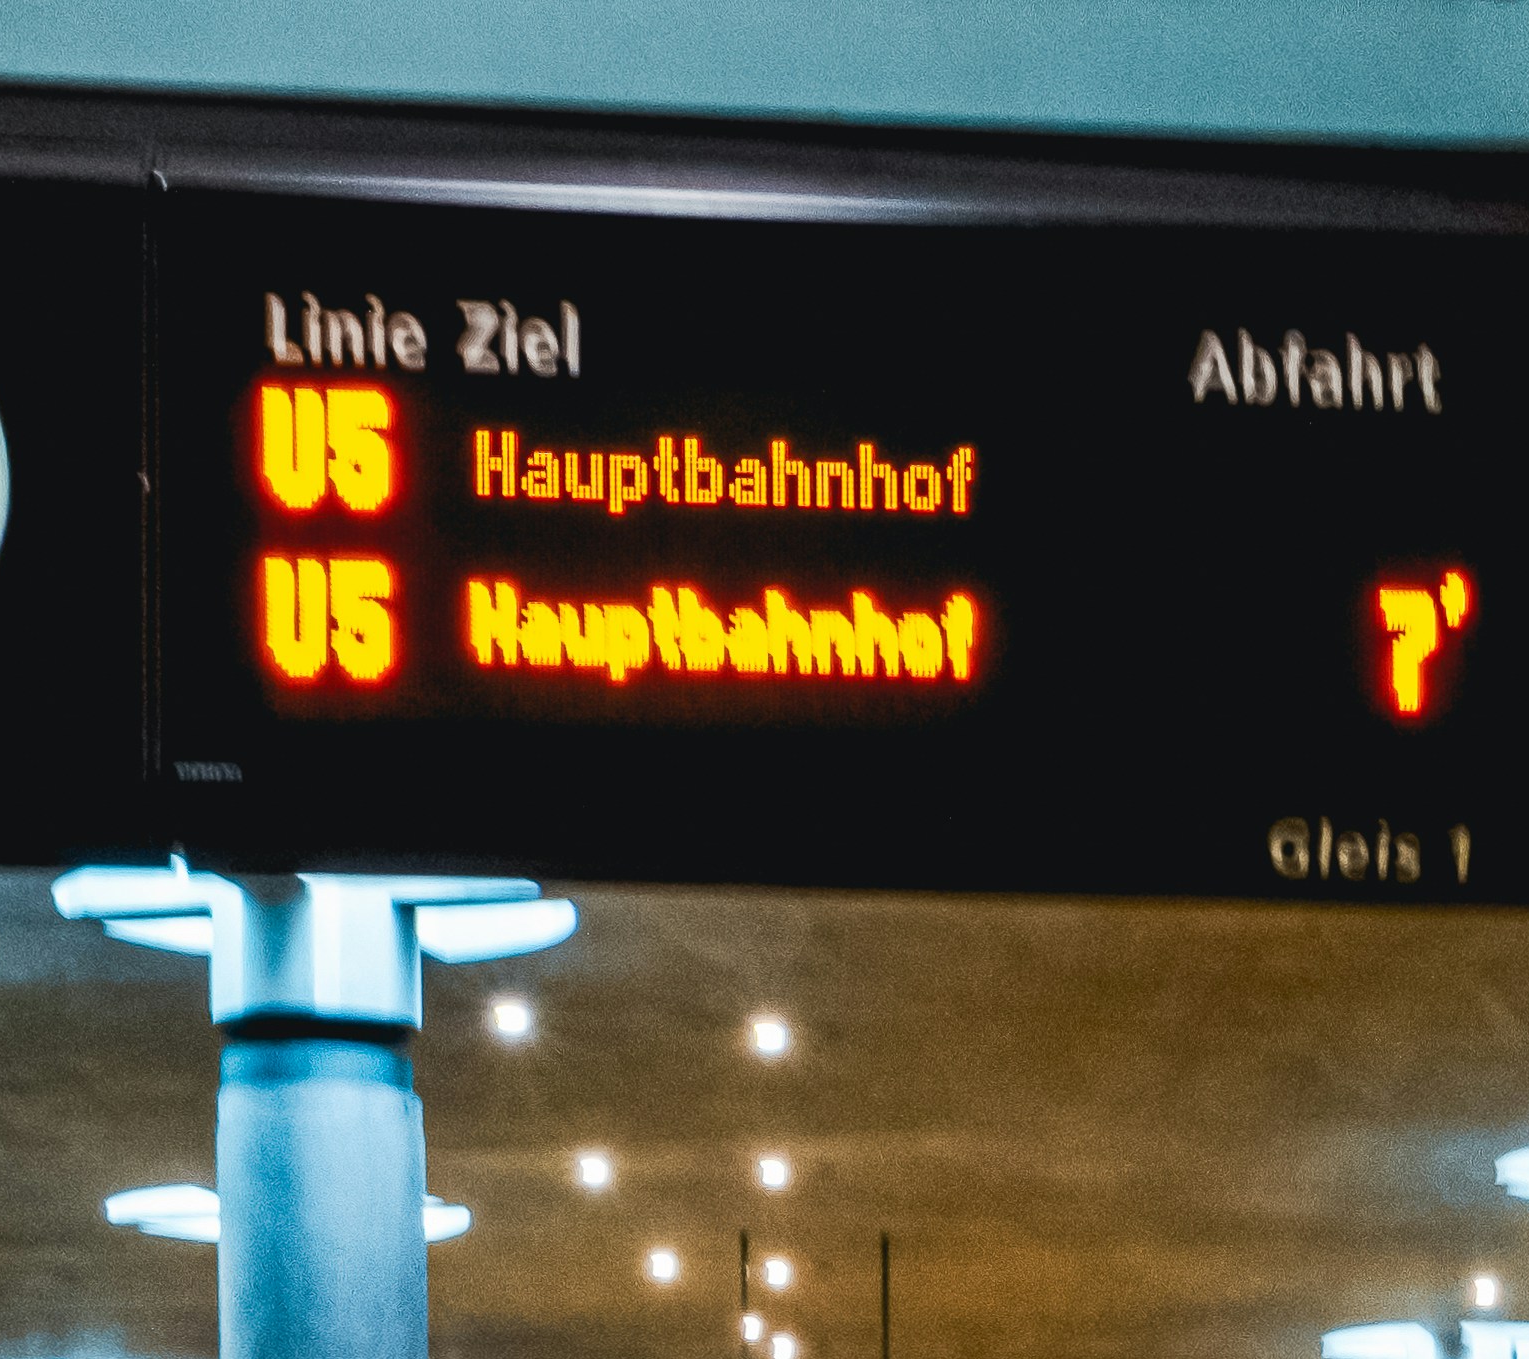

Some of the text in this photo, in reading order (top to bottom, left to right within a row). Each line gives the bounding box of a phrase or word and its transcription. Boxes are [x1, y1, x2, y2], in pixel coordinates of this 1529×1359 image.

[265, 291, 581, 378] Linie Ziel
[1187, 326, 1444, 415] Abfahrt
[260, 384, 973, 514] U5 Hauptbahnhof
[263, 556, 394, 681] U5
[468, 580, 974, 683] Hauptbahnhof
[1267, 816, 1471, 885] Gleis 1
